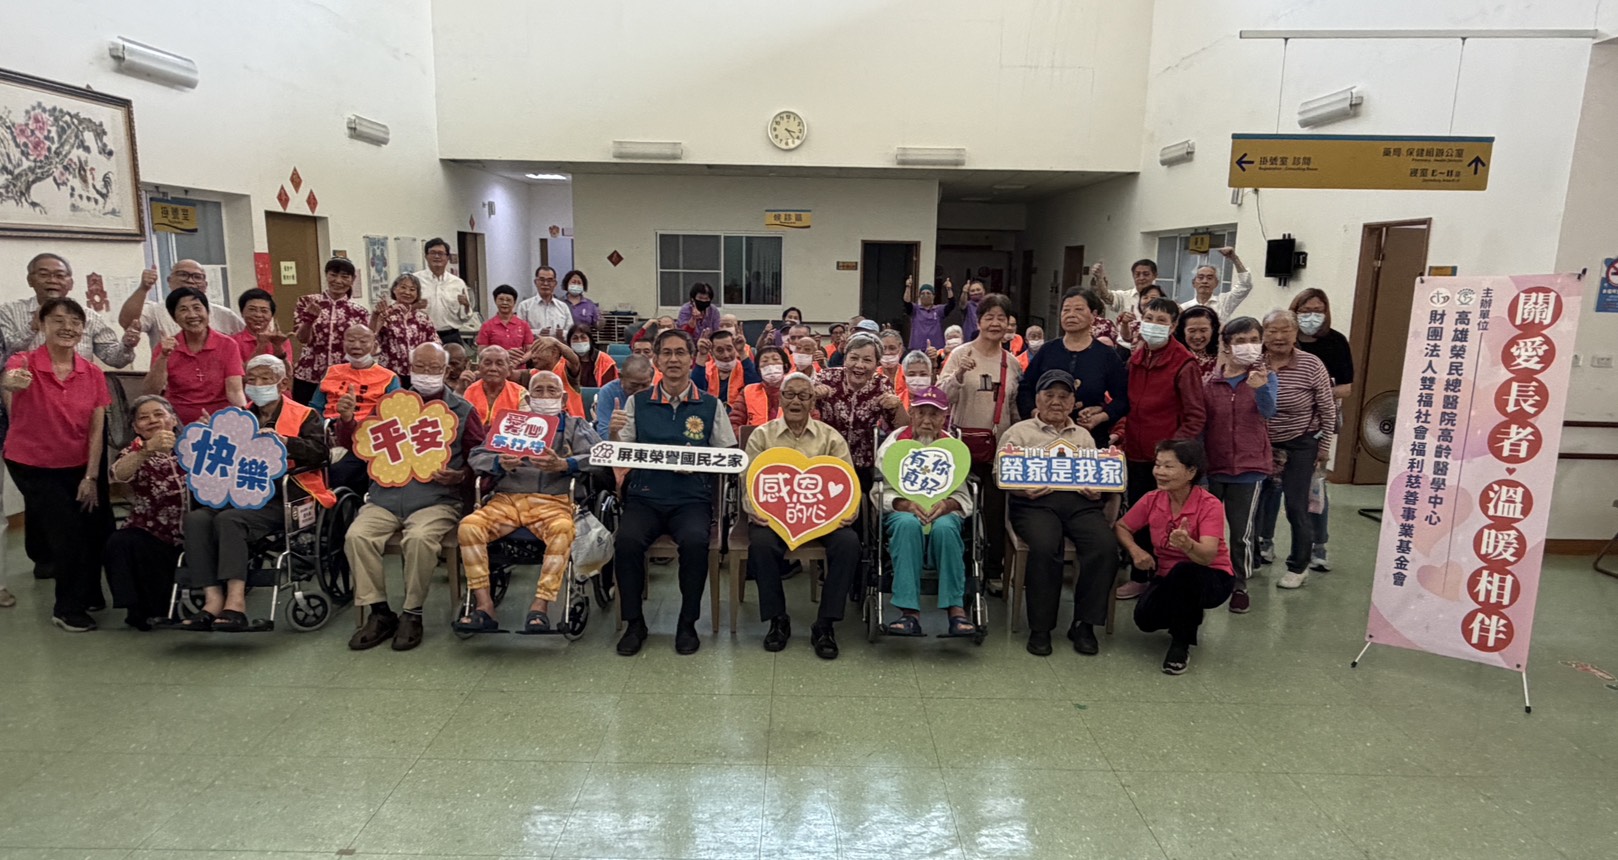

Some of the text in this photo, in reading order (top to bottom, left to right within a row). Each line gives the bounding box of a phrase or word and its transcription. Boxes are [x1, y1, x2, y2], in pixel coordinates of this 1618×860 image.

[1477, 288, 1494, 331] 主辦單位
[1424, 310, 1472, 526] 高雄榮民總醫院高齡醫學中心
[369, 418, 444, 464] 平安
[617, 448, 744, 468] 屏東榮譽國民之家
[1392, 310, 1446, 587] 財團法人雙福社會福利慈善事業基金會
[191, 428, 269, 492] 快樂
[910, 451, 952, 476] 有你
[1002, 458, 1122, 484] 榮家是我家
[1468, 291, 1557, 648] 關愛長者 溫暖相伴
[758, 472, 824, 503] 感恩
[901, 468, 940, 494] 真好
[786, 503, 827, 524] 的心
